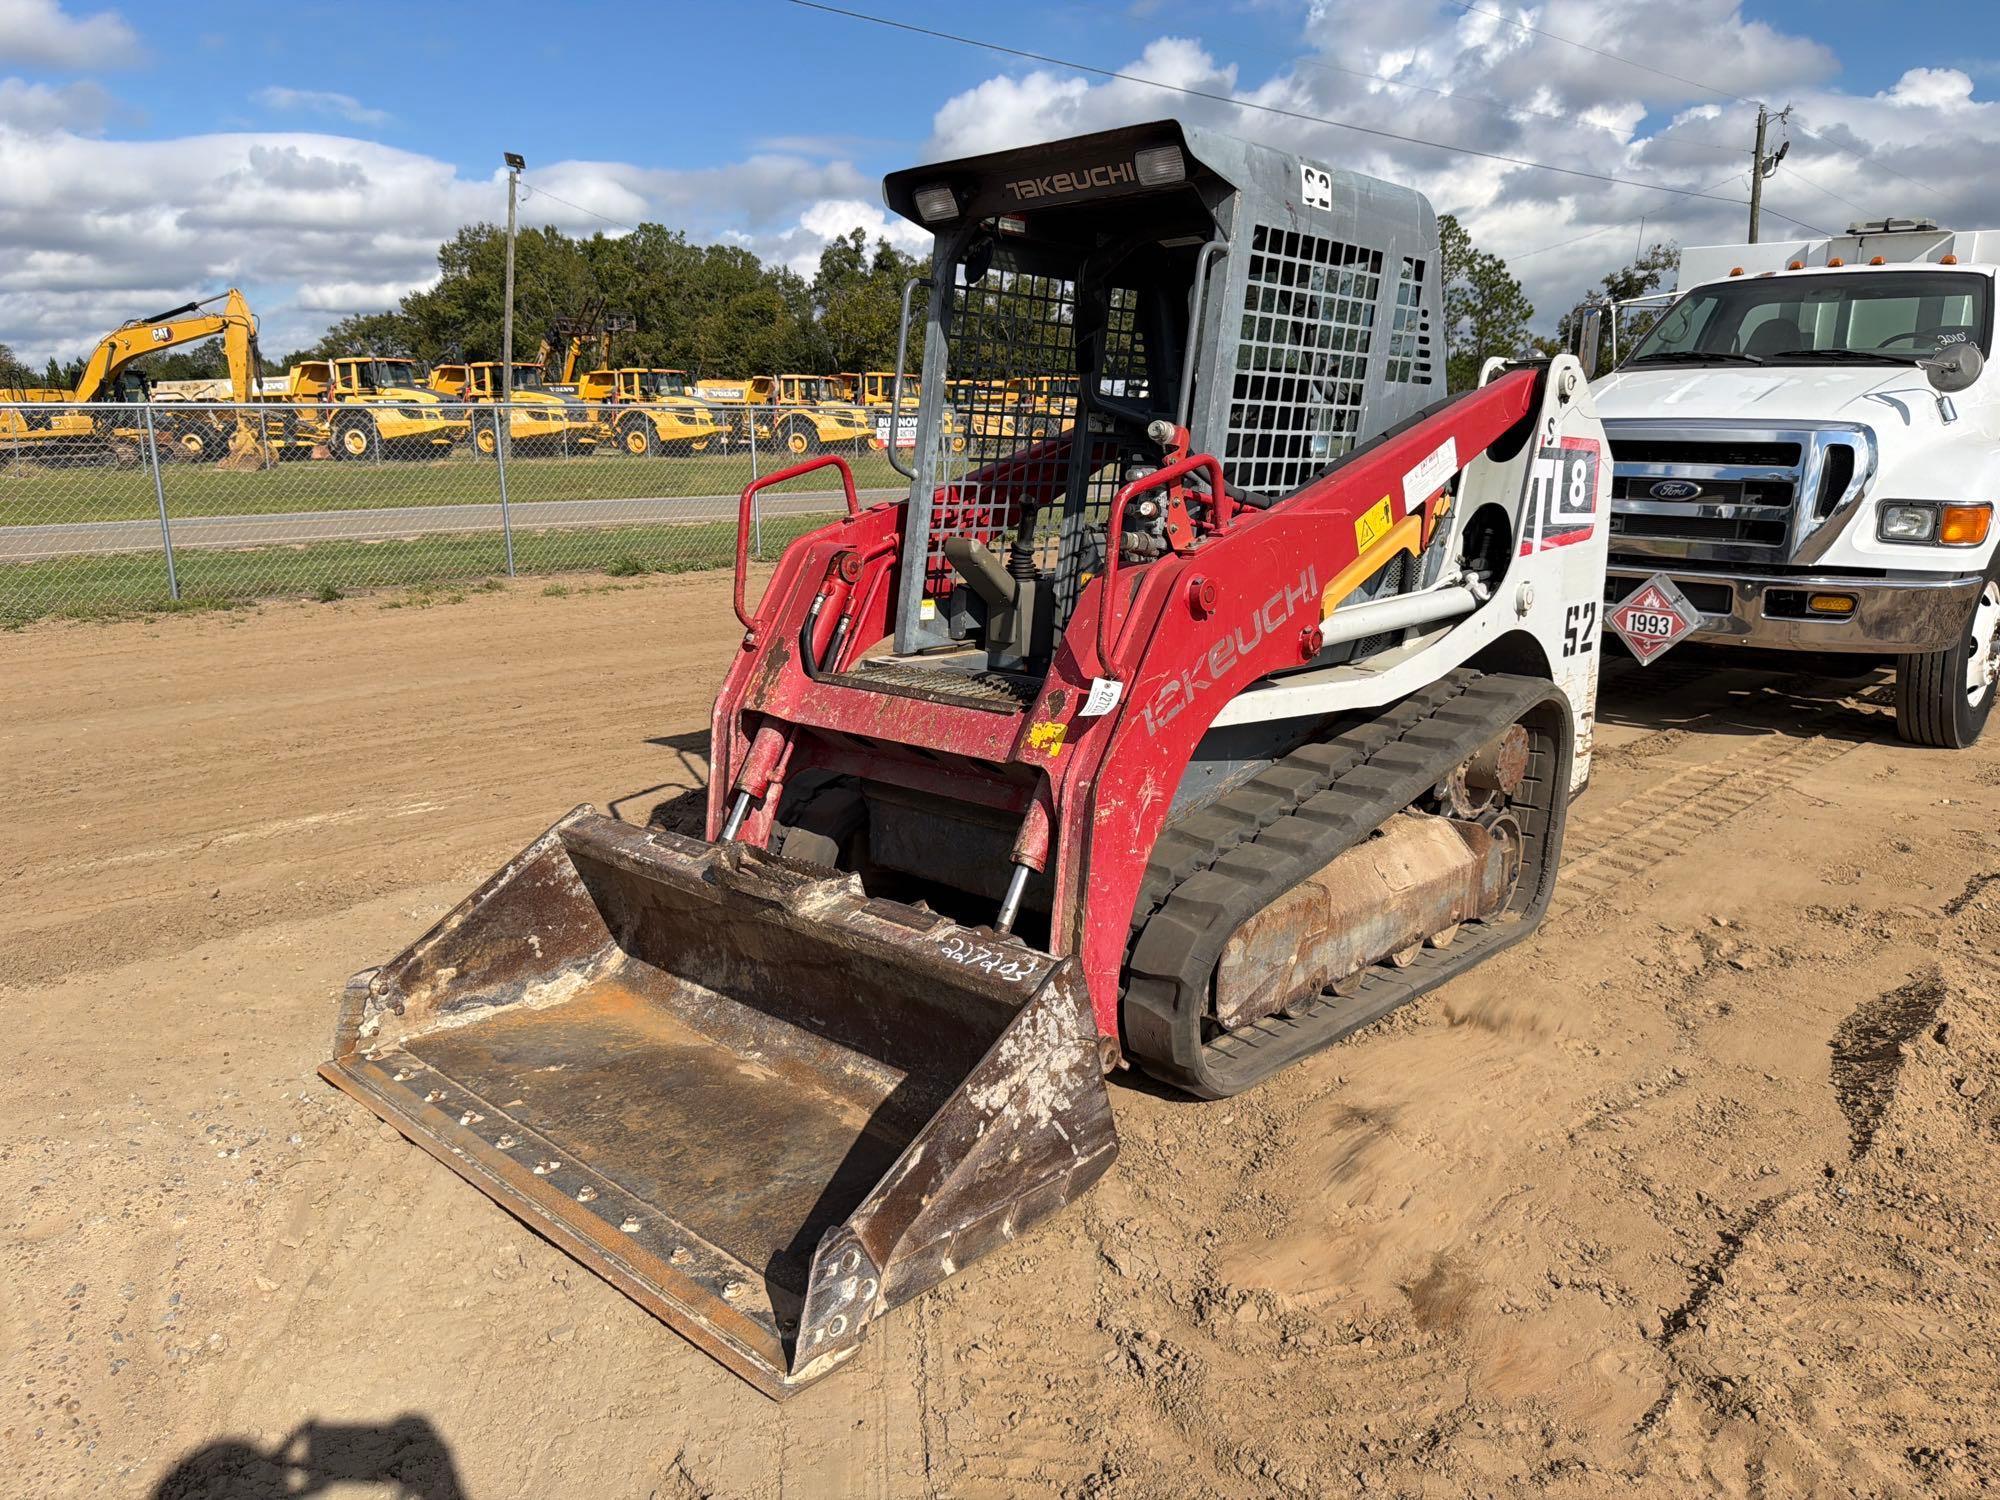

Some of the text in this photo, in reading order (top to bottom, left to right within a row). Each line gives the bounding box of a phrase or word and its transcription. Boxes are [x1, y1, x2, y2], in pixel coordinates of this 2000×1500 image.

[1005, 161, 1136, 200] TAKEUCHI
[152, 327, 169, 341] CAT
[711, 390, 740, 398] VOLVO
[1660, 483, 1688, 496] Ford
[1562, 601, 1597, 658] S2
[1630, 612, 1671, 636] 1993
